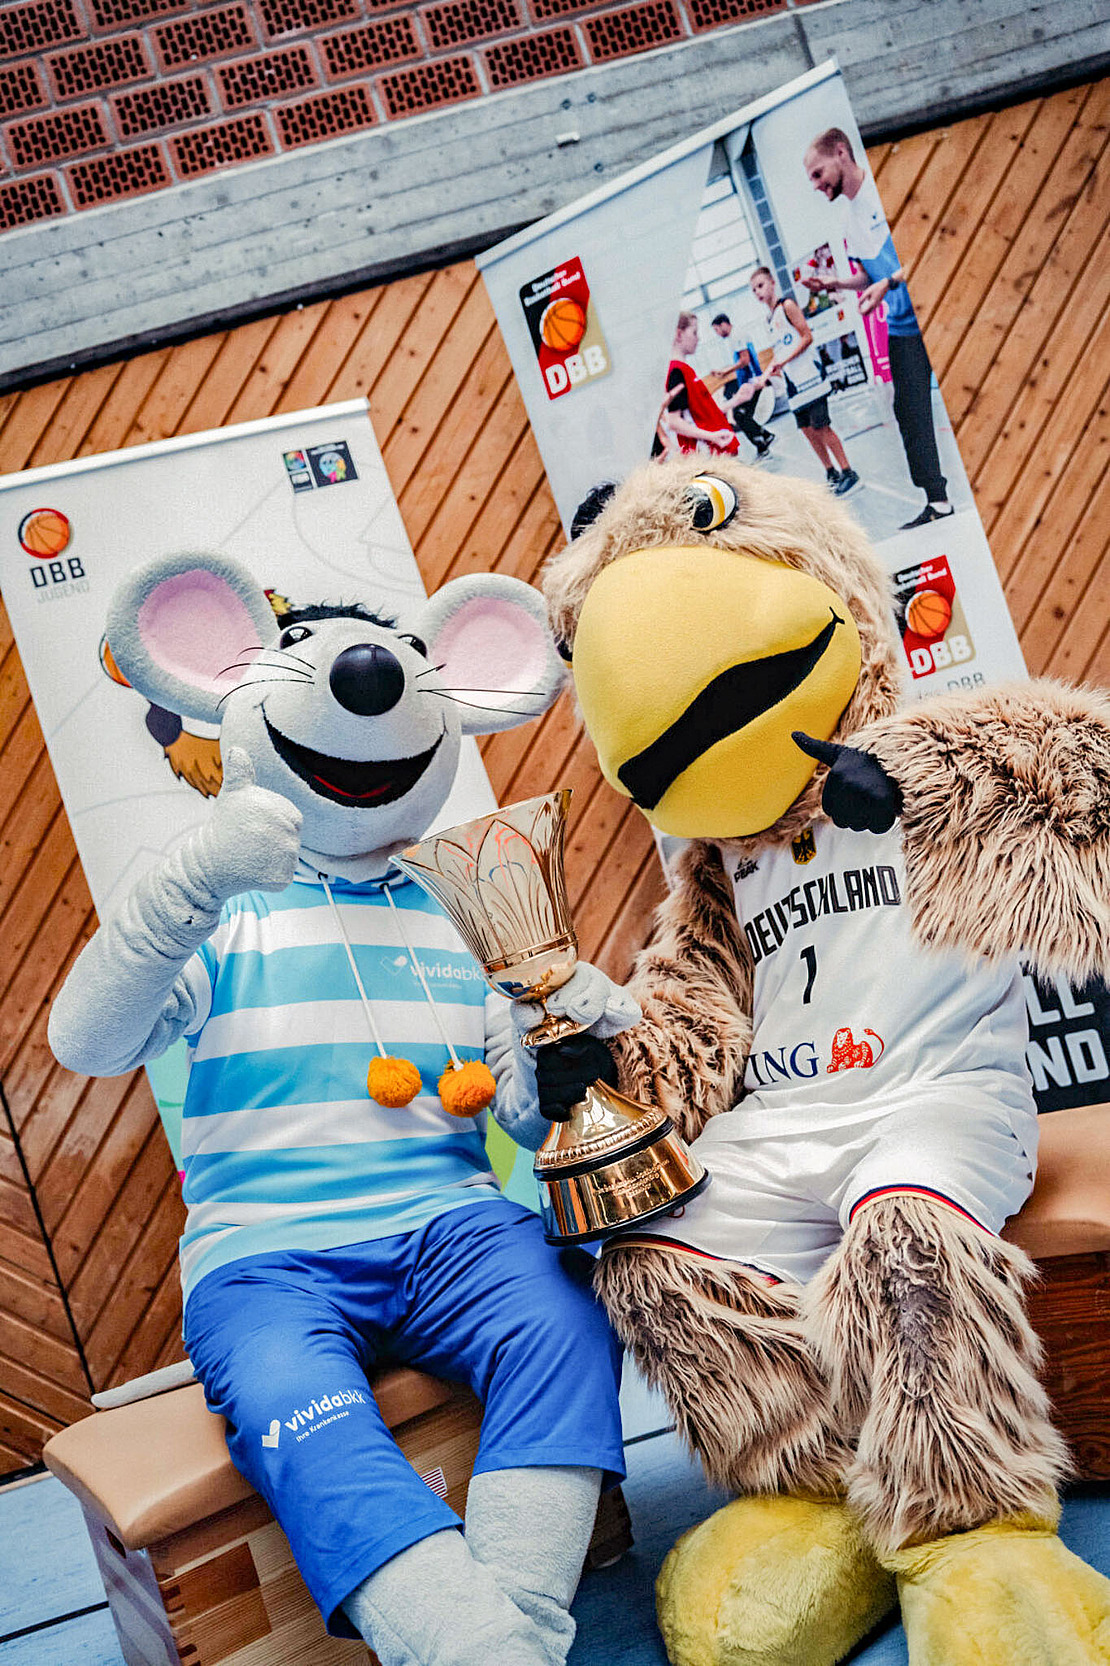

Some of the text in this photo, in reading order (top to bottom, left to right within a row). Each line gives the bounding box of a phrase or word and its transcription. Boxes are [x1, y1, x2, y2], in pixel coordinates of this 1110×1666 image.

[545, 345, 607, 394] DBB
[30, 557, 85, 588] DBB
[910, 634, 973, 675] DBB
[743, 865, 902, 966] DEUTSCHLAND
[410, 961, 481, 980] vividabk
[800, 944, 818, 1005] 1
[748, 1042, 819, 1086] ING
[284, 1389, 367, 1431] vividabkk
[296, 1431, 310, 1443] Ihre
